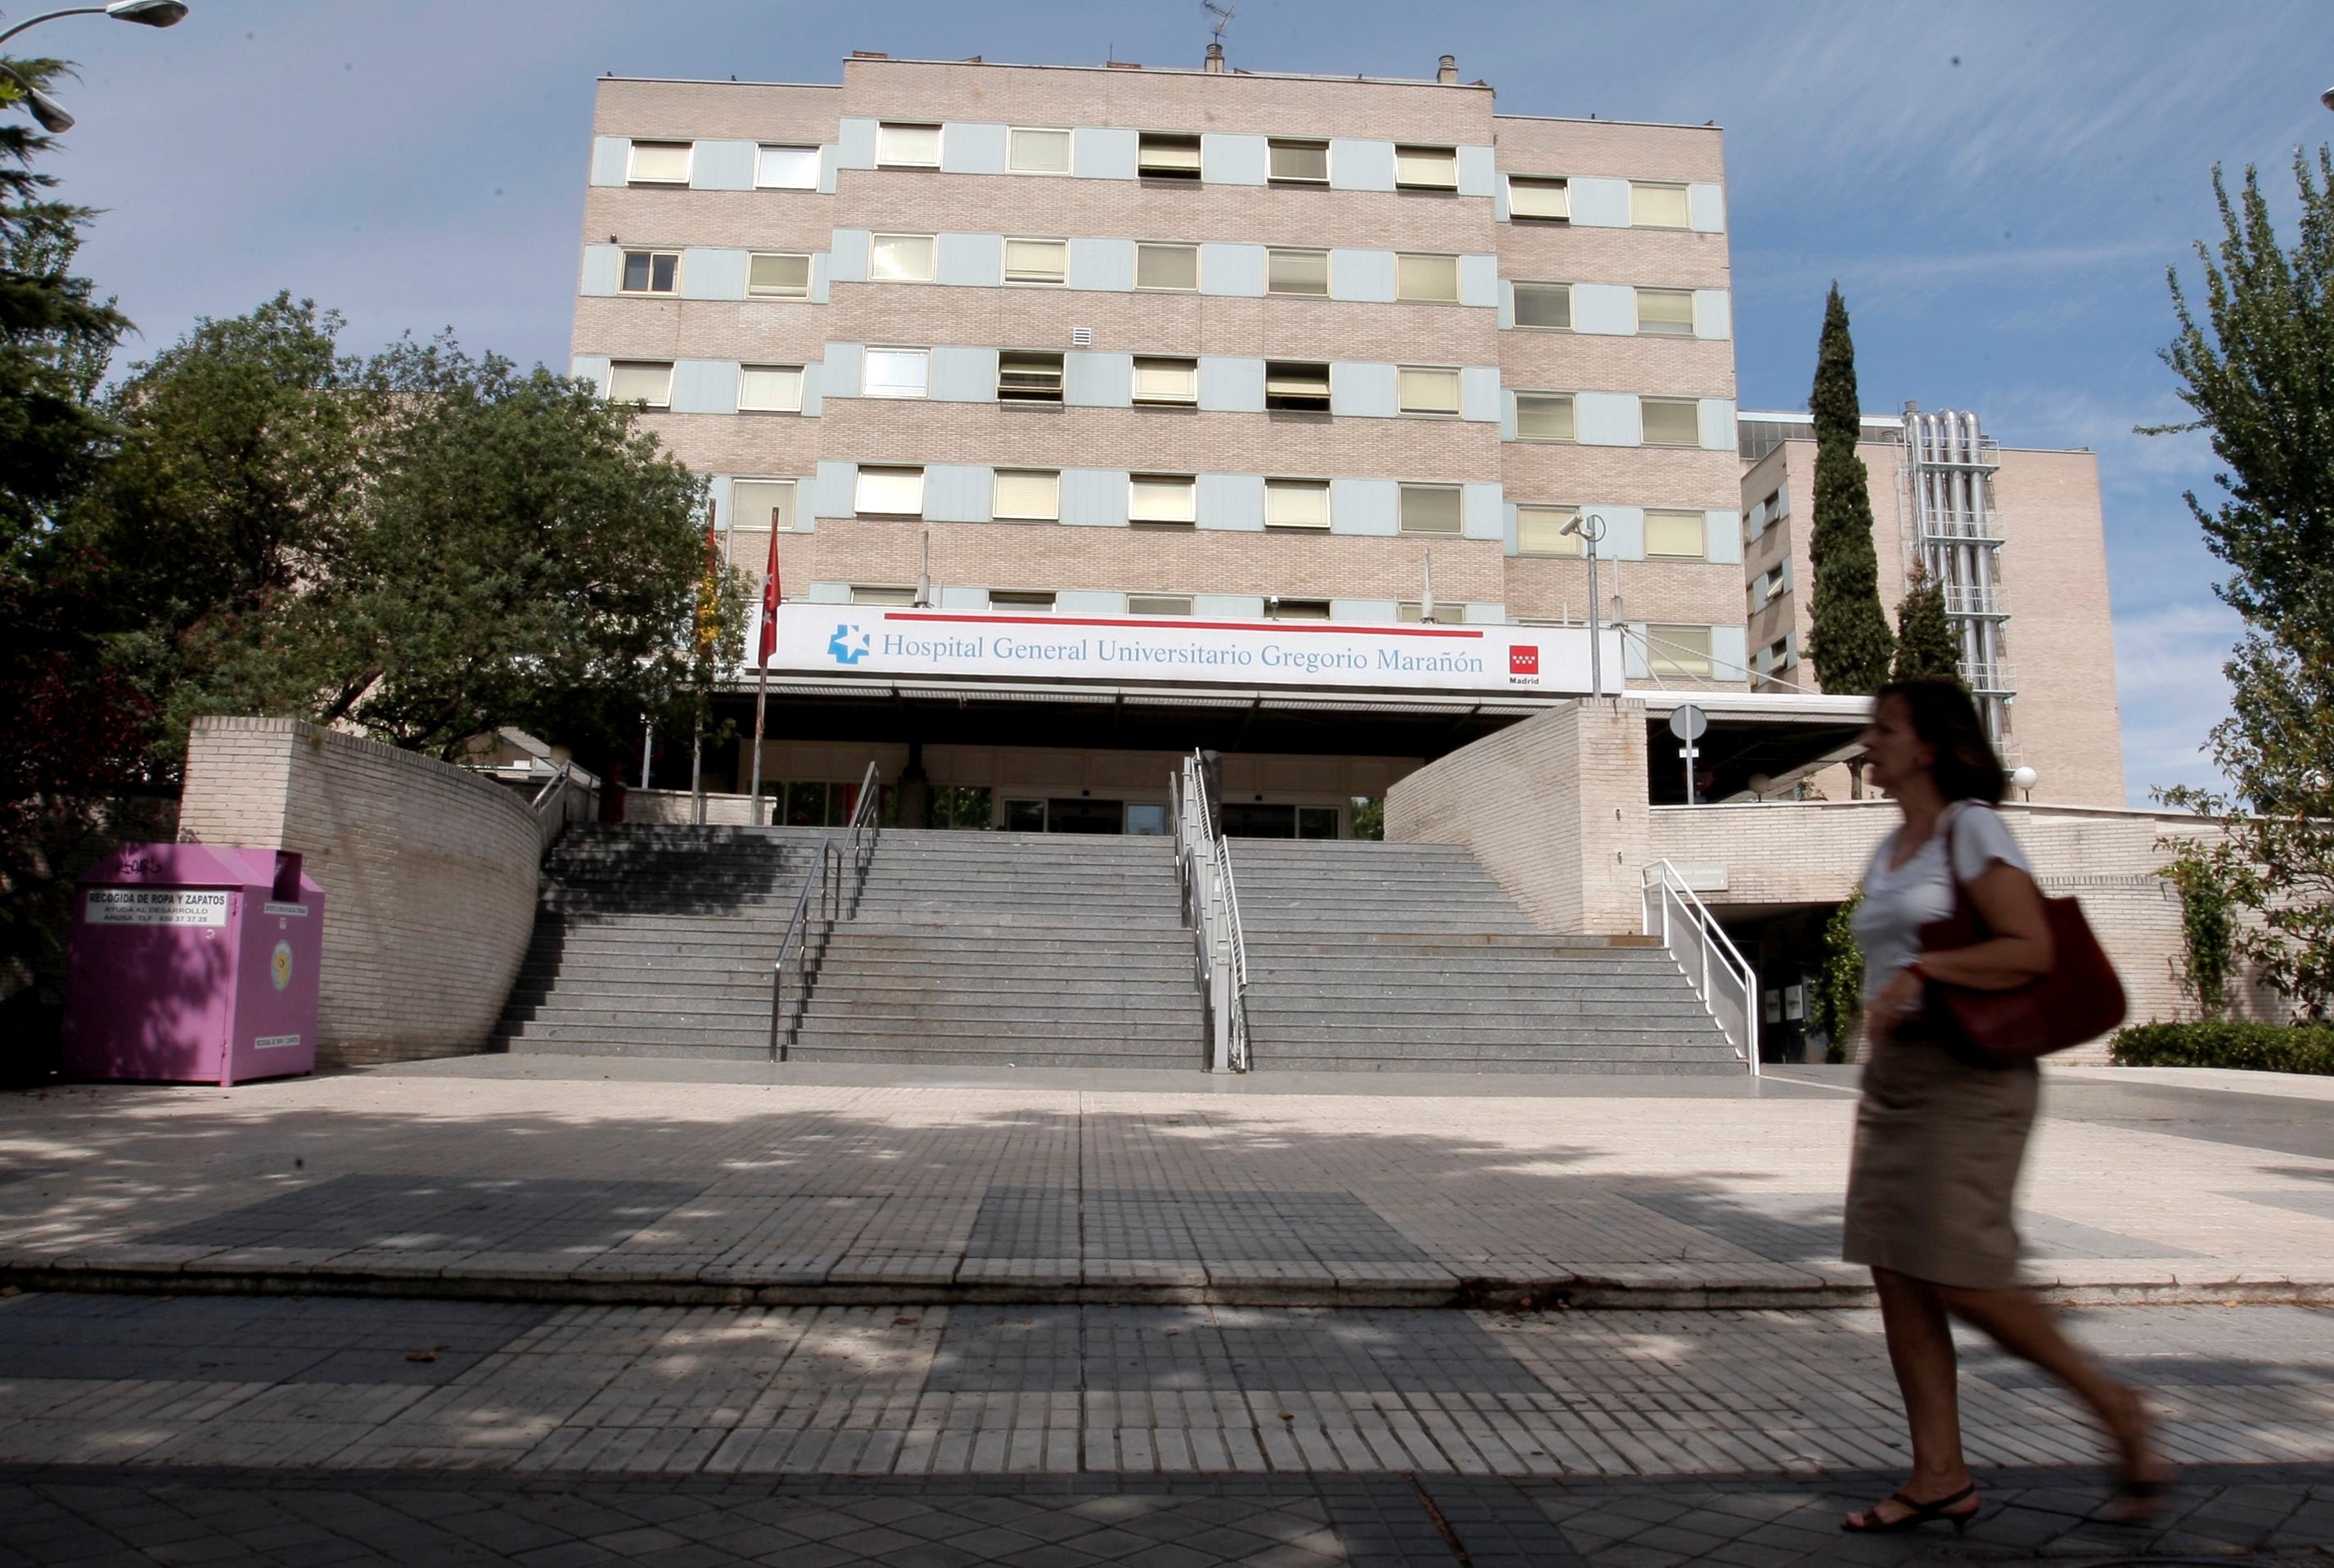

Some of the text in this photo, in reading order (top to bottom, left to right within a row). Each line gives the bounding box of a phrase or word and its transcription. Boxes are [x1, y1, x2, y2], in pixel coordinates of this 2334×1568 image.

[883, 633, 1485, 674] Hospital General Universitario Gregorio Marañón
[1509, 677, 1539, 685] Madrid
[89, 893, 225, 905] RECOGIDA DE ROPA Y ZAPATOS
